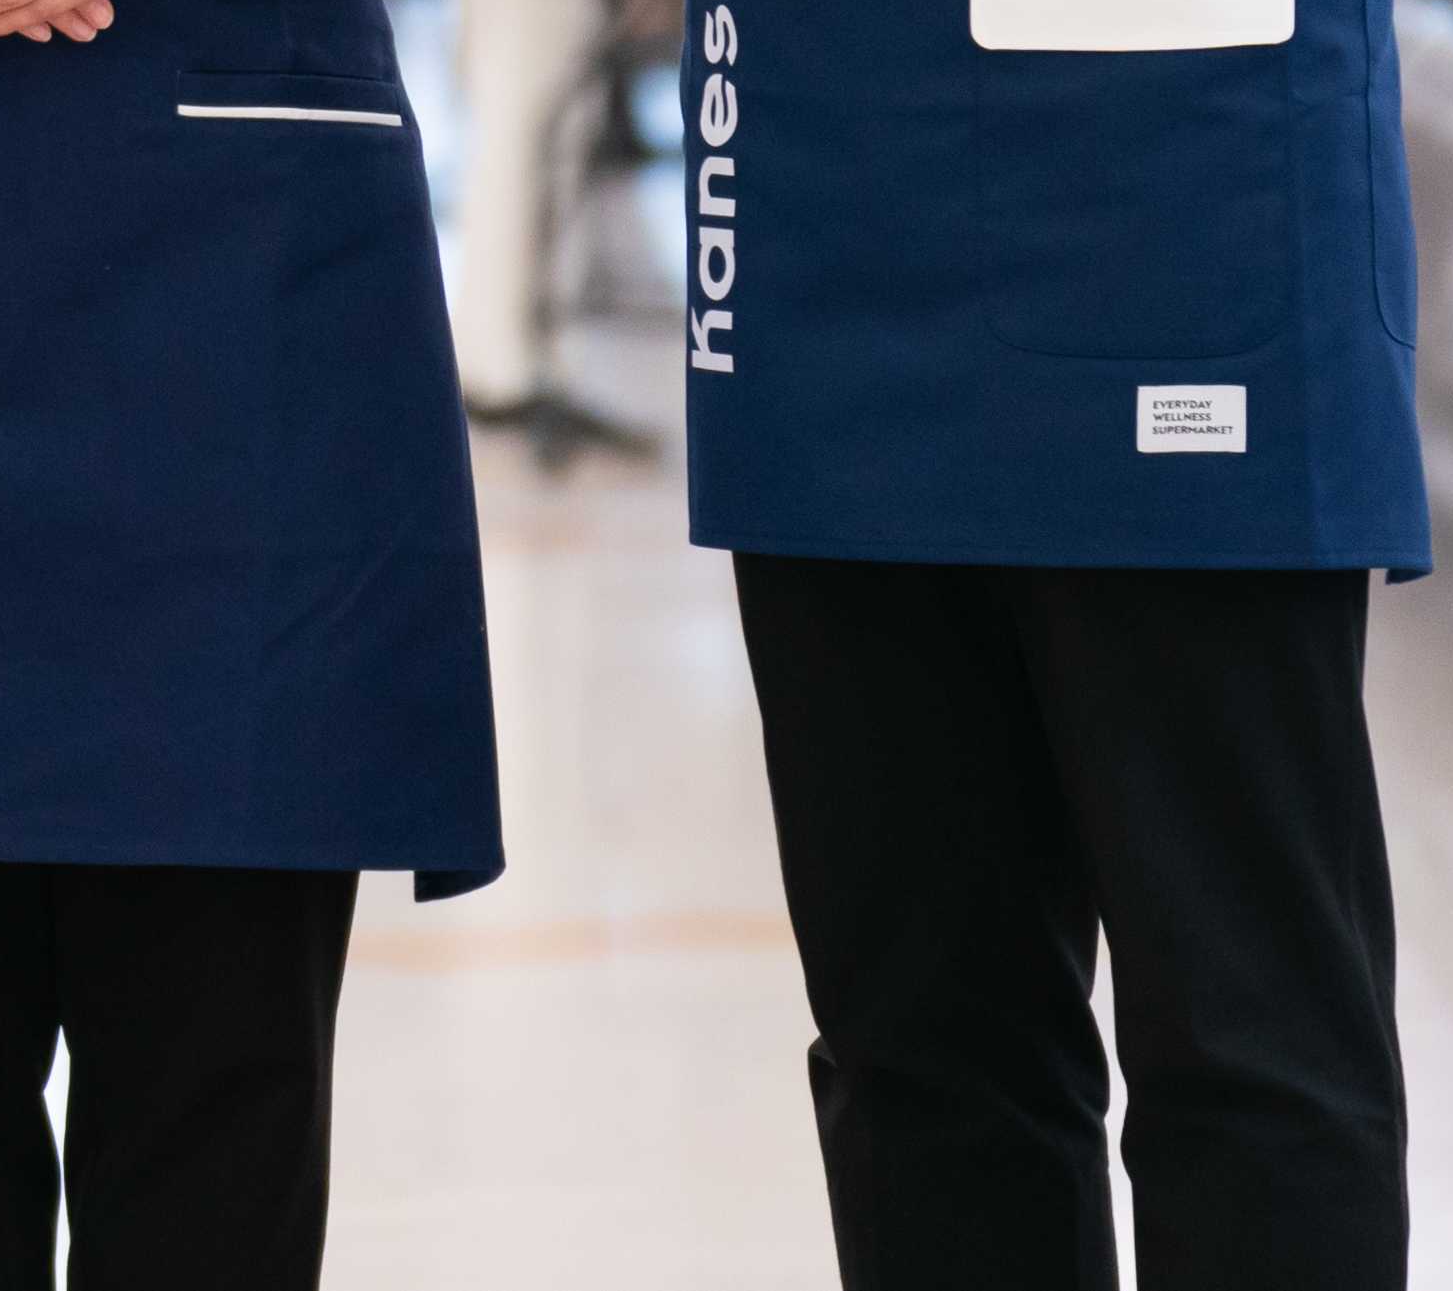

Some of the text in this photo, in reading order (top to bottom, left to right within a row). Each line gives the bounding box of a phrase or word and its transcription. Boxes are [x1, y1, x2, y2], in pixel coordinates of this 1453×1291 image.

[1152, 400, 1213, 410] EVERYDAY
[1152, 412, 1212, 422] WELLNESS
[1152, 425, 1234, 435] SUPERMARKET
